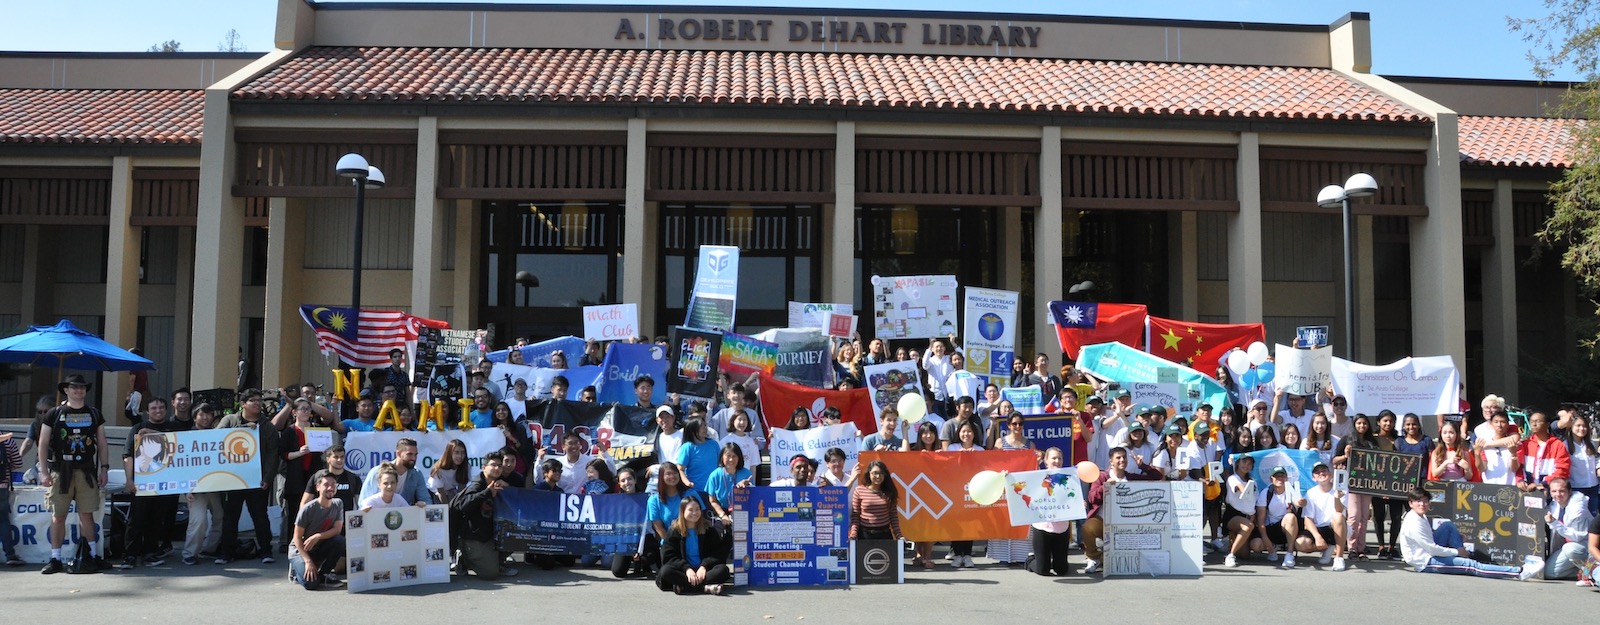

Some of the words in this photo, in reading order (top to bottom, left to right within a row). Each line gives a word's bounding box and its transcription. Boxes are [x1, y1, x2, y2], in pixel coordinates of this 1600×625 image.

[614, 18, 646, 40] A.
[658, 18, 774, 41] ROBERT
[788, 20, 907, 43] DEHART
[922, 23, 1042, 48] LIBRARY
[975, 302, 1009, 310] ASSOCIATION
[586, 306, 623, 321] Math
[440, 329, 475, 339] VIETNAMESE
[602, 324, 633, 338] Club
[444, 337, 470, 347] STUDENT
[681, 343, 710, 354] CLICK
[436, 345, 467, 354] ASSOCIAT
[732, 342, 768, 364] SAGA
[687, 352, 705, 362] THE
[775, 350, 824, 366] OURNEY
[677, 361, 711, 373] WORLD
[1356, 370, 1390, 382] Christians
[1393, 370, 1408, 382] On
[1410, 370, 1439, 382] Campus
[1135, 382, 1158, 390] Career
[528, 422, 615, 455] DASB
[1036, 428, 1044, 439] K
[1045, 427, 1072, 439] CLUB
[167, 441, 185, 454] De
[191, 440, 225, 452] Anza
[777, 440, 805, 452] Child
[807, 436, 851, 450] Educator
[167, 454, 211, 468] Anime
[218, 450, 250, 465] Club
[598, 444, 654, 461] NATE
[1353, 451, 1416, 475] INJOY
[1348, 477, 1388, 491] CULTURAL
[1391, 481, 1415, 493] CLUB
[1456, 482, 1475, 490] KPOP
[817, 501, 845, 509] Quarter
[1456, 490, 1472, 511] K
[1472, 494, 1497, 503] DANCE
[559, 493, 597, 523] ISA
[1478, 502, 1494, 523] D
[1494, 509, 1515, 518] CLUB
[540, 521, 559, 529] IRANIAN
[561, 522, 582, 530] STUDENT
[584, 522, 613, 530] ASSOCIATION
[1494, 517, 1513, 537] C
[753, 542, 770, 550] First
[773, 542, 803, 551] Meeting:
[779, 560, 806, 568] Chamber
[1111, 555, 1139, 574] EVENTS
